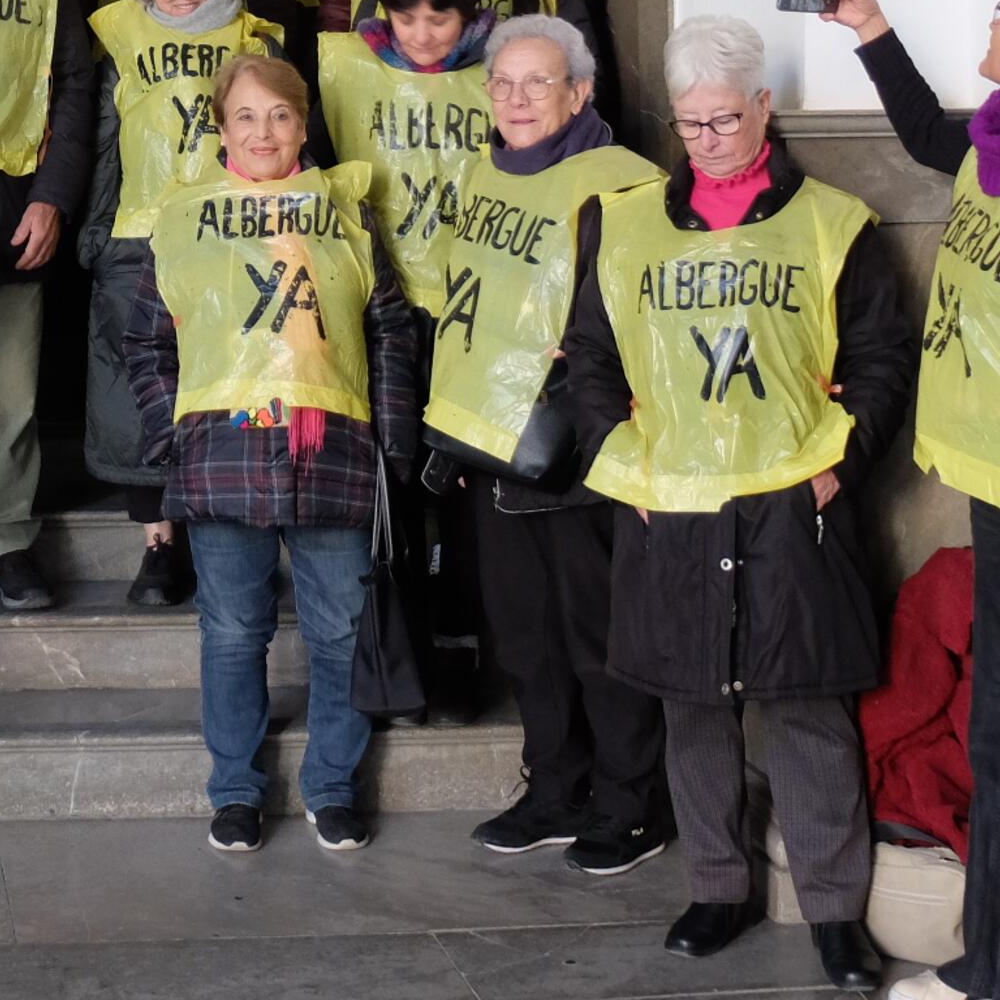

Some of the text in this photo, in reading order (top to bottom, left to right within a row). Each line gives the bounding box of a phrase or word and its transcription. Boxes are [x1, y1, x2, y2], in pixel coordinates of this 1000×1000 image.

[240, 260, 327, 341] YA
[436, 263, 481, 354] YA
[638, 258, 805, 314] ALBERGUE
[689, 324, 766, 404] YA
